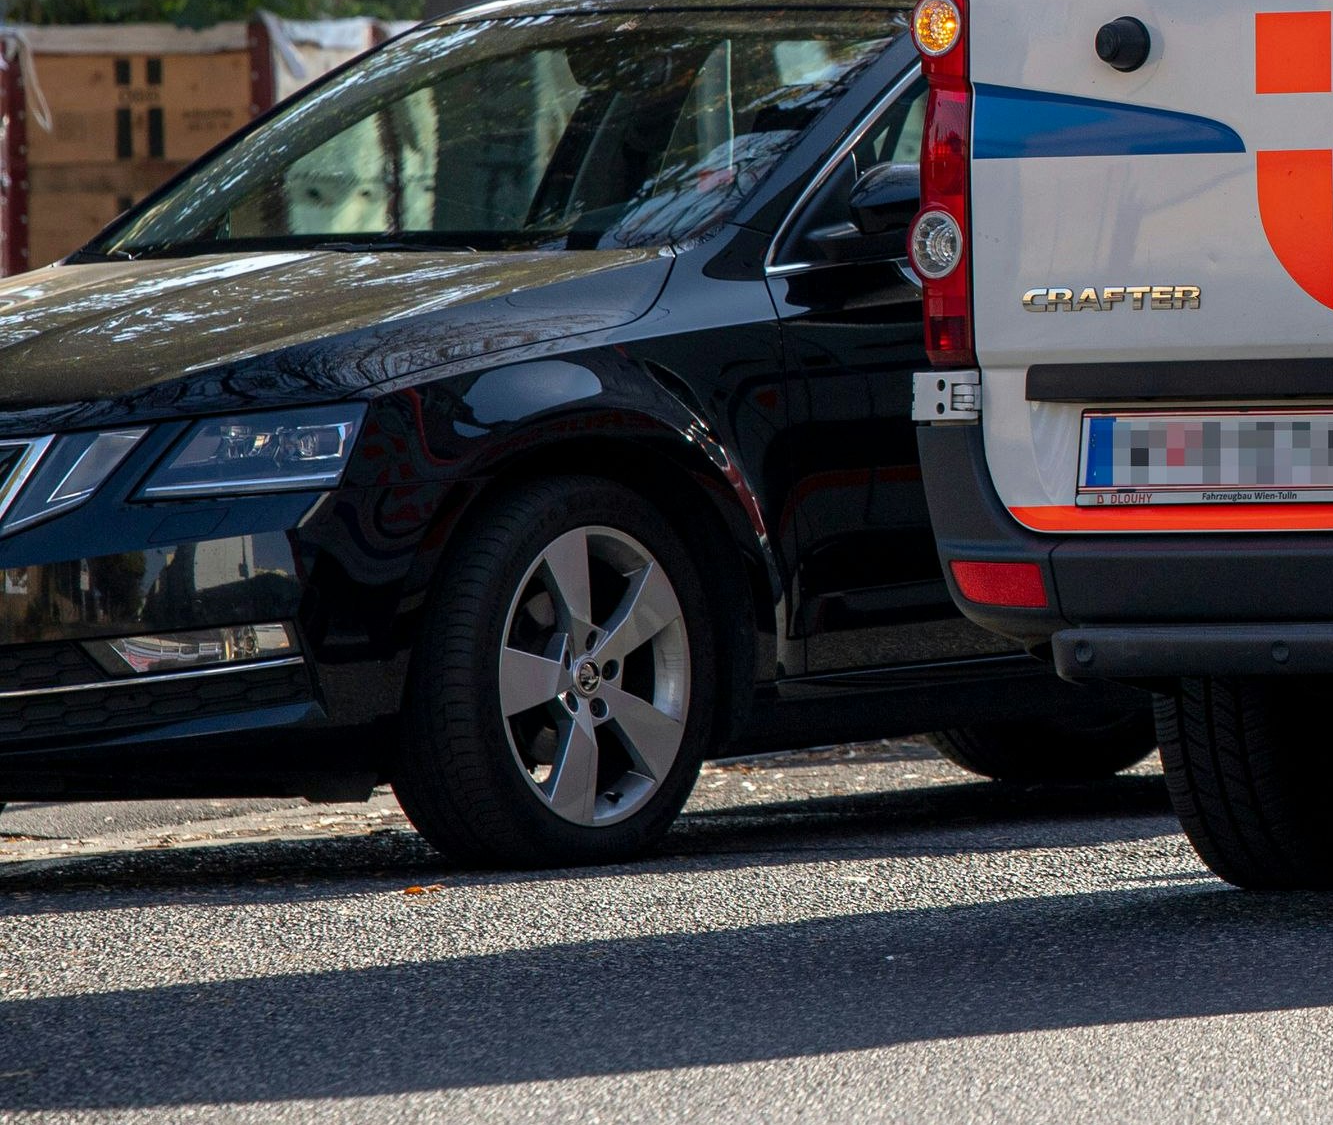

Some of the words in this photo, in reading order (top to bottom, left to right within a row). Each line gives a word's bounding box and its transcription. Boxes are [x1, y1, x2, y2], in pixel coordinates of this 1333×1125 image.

[1022, 285, 1202, 313] CRAFTER
[1110, 493, 1153, 505] DLOUHY
[1201, 491, 1252, 503] Fahrzeugbau
[1254, 490, 1298, 501] Wien-Tulln
